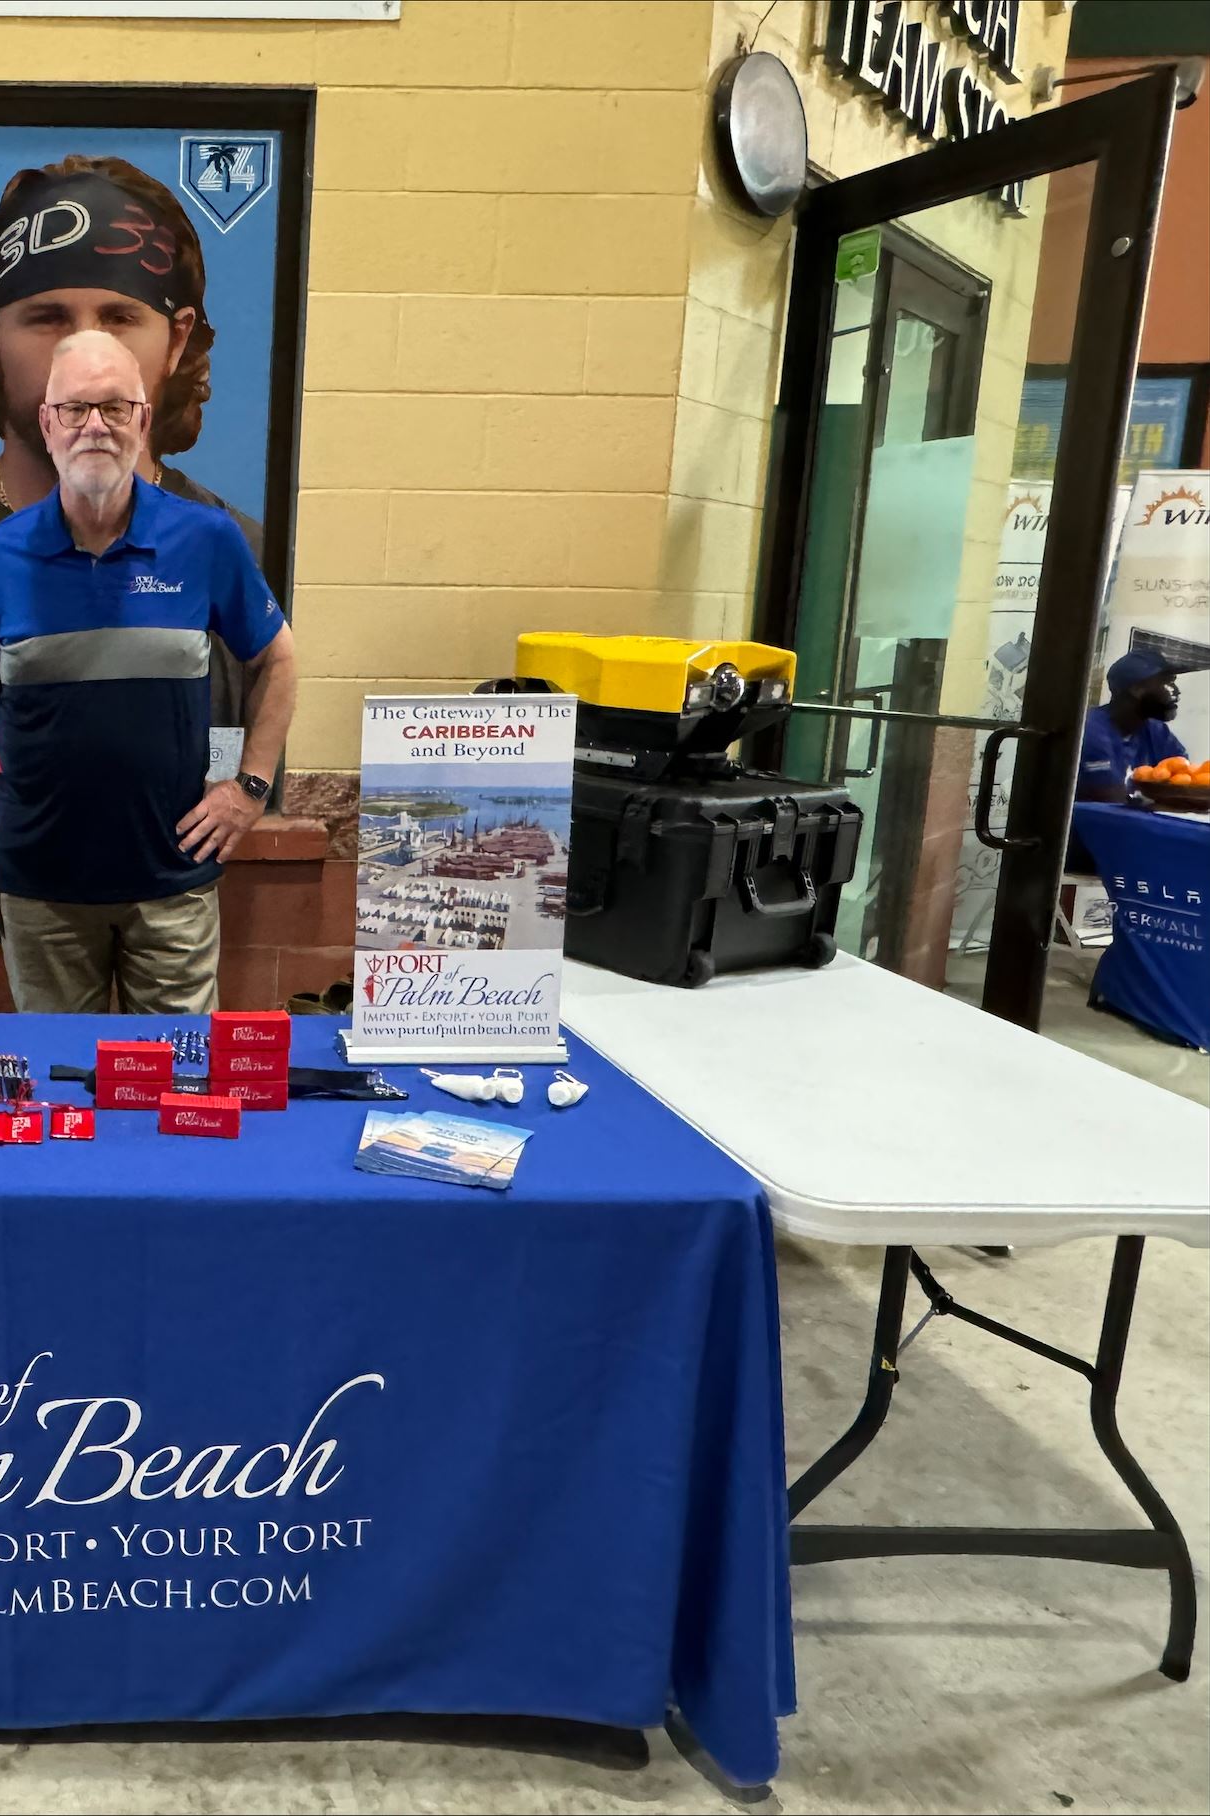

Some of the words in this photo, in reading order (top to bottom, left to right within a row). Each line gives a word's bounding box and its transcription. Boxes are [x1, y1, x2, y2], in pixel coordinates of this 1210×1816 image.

[368, 706, 406, 720] The
[412, 705, 496, 724] Gateway
[501, 705, 526, 719] To
[537, 704, 572, 719] The
[402, 725, 536, 740] CARIBBEAN
[410, 743, 446, 757] and
[453, 742, 525, 761] Beyond
[385, 953, 449, 975] PORT
[443, 963, 466, 986] of
[381, 973, 455, 1008] Palm
[456, 972, 555, 1007] Beach
[25, 1372, 386, 1509] Beach
